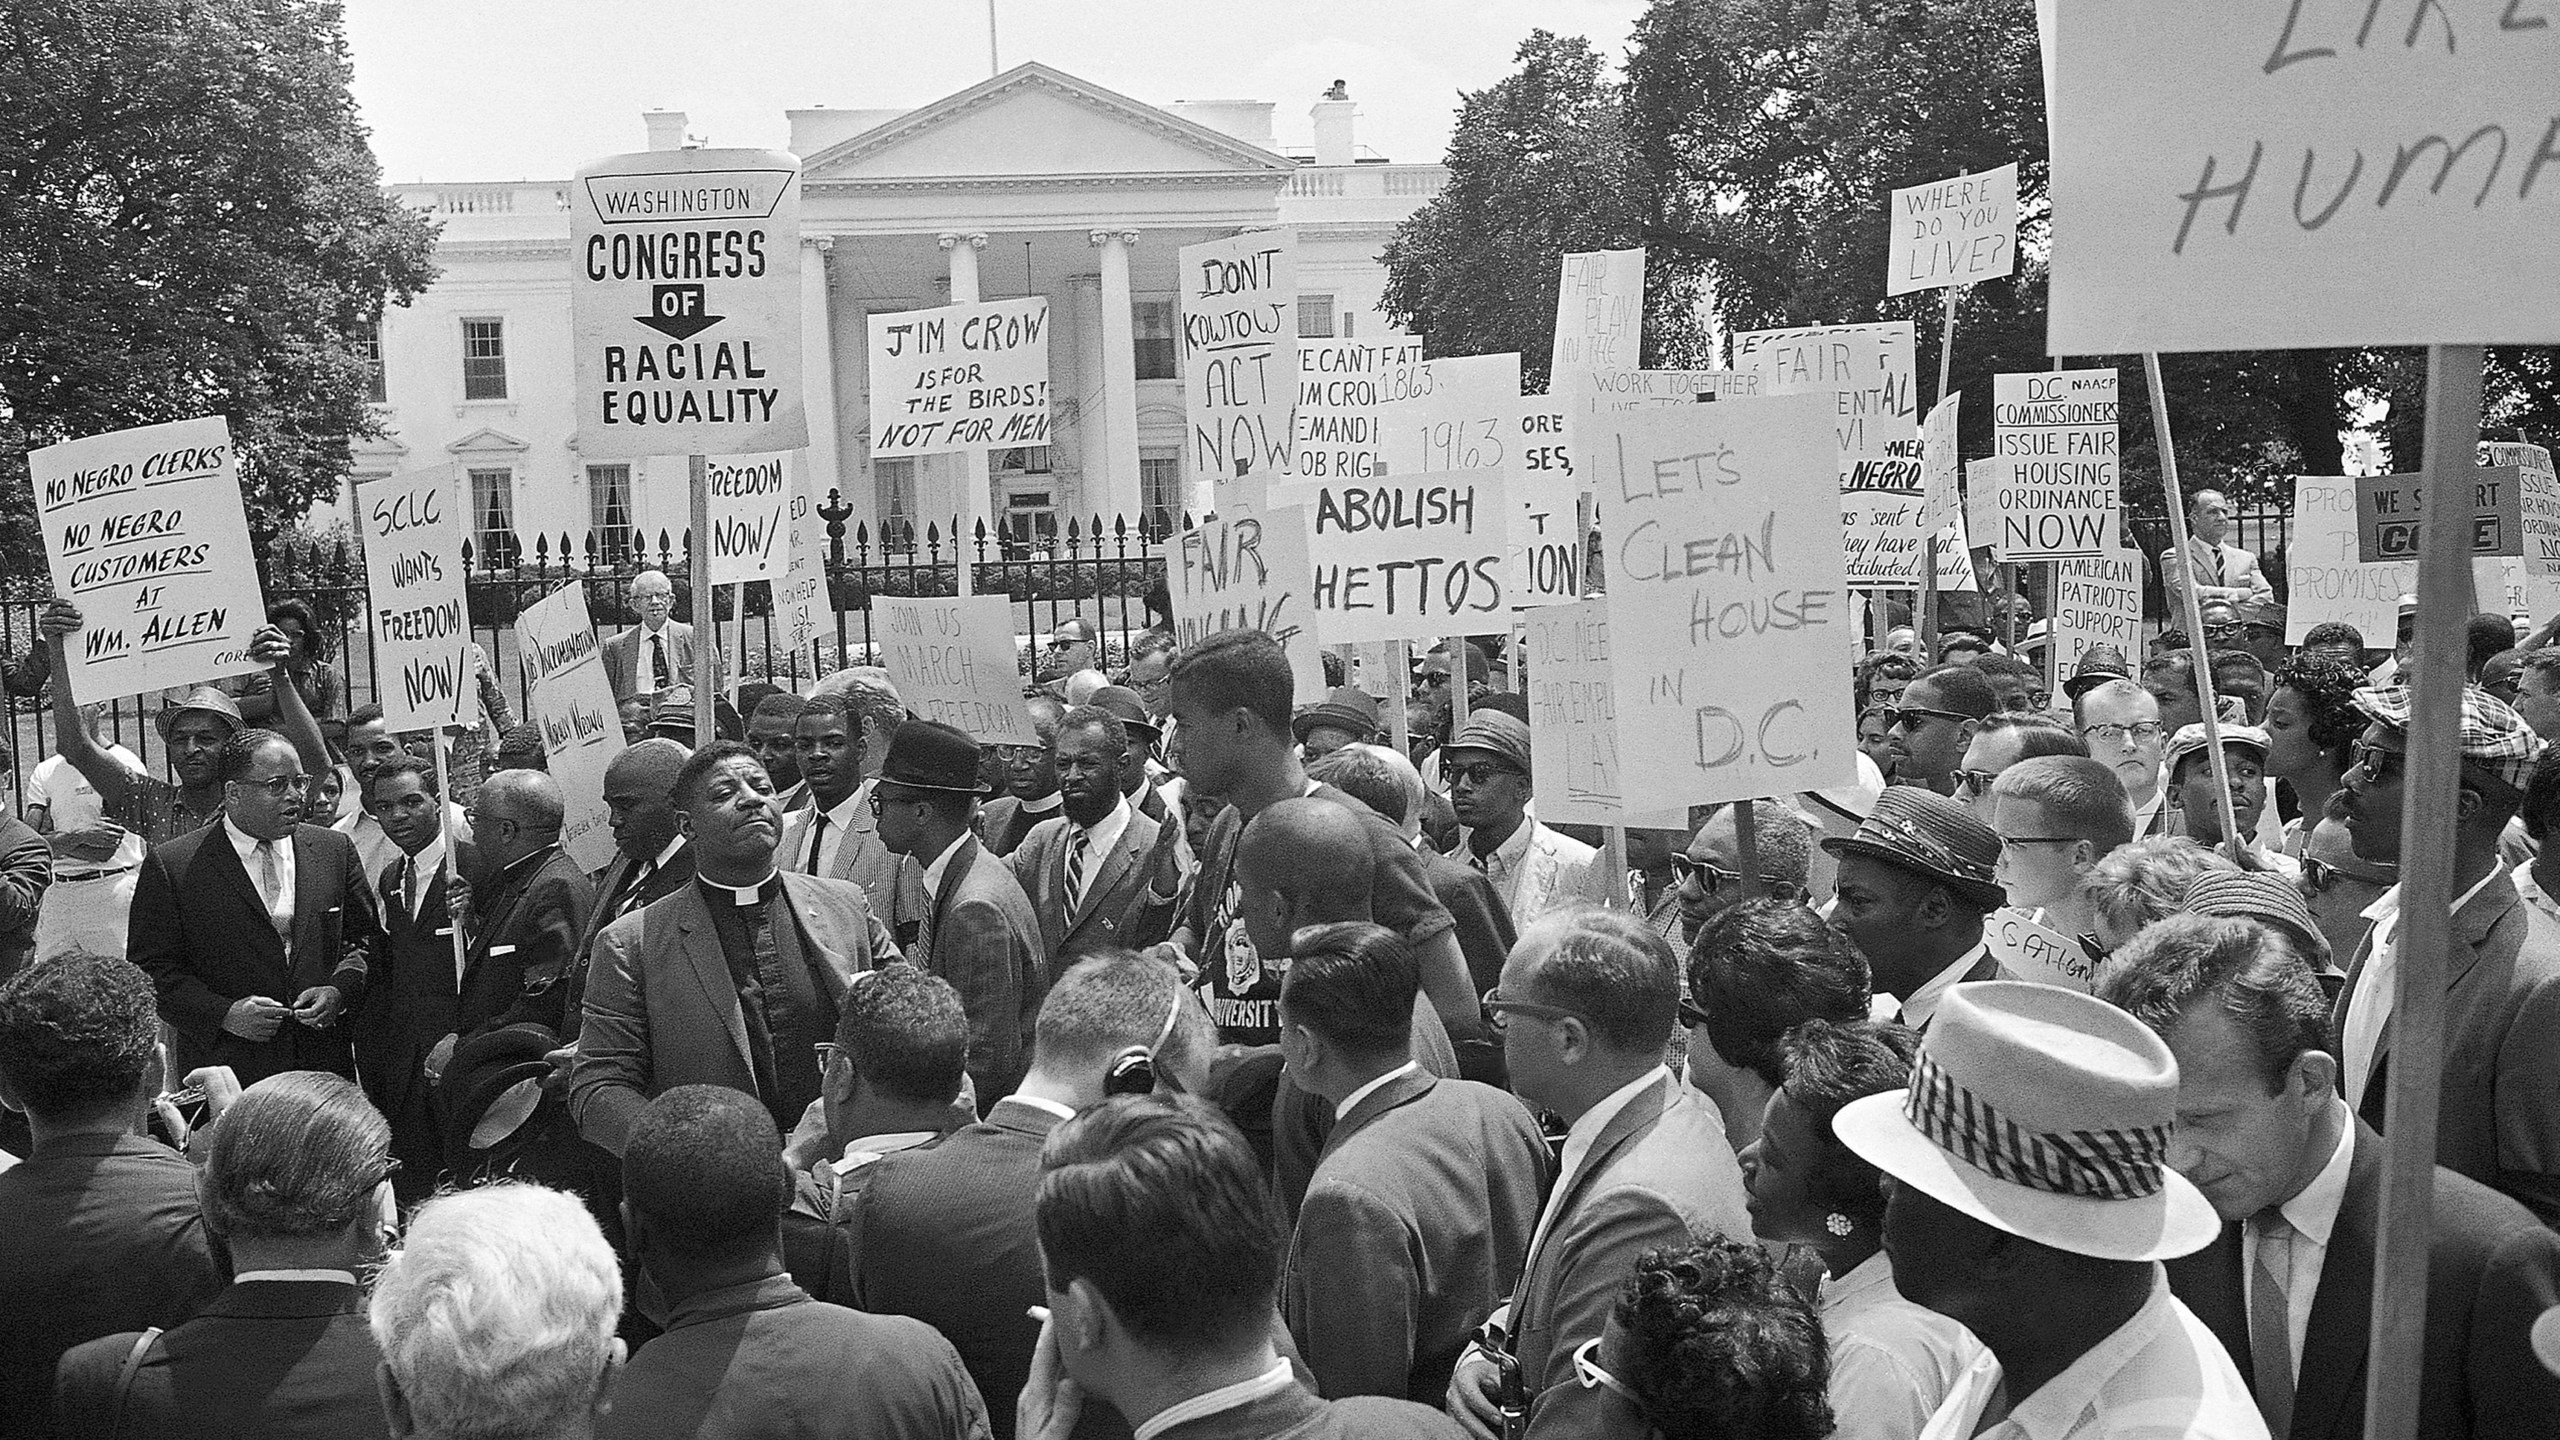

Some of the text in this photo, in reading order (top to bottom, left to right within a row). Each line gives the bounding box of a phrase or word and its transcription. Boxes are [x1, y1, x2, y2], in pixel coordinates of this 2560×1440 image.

[605, 188, 751, 214] WASHINGTON
[1906, 178, 1991, 215] WHERE
[1914, 207, 1999, 240] DO YOU
[586, 229, 766, 282] CONGRESS
[1566, 253, 1608, 296] FAIR
[1910, 234, 2006, 280] LIVE?
[660, 290, 698, 318] OF
[1585, 294, 1635, 336] PLAY
[885, 305, 1048, 356] JIM CROW
[1182, 302, 1288, 361] KOWTOW
[605, 340, 766, 383] RACIAL
[1561, 337, 1580, 363] IN
[1776, 343, 1851, 385] FAIR
[905, 380, 1047, 414] THE BIRDS!
[1205, 351, 1272, 408] ACT
[1592, 371, 1759, 396] WORK TOGETHER
[2028, 377, 2116, 400] D.C. NAACP
[602, 388, 779, 426] EQUALITY
[877, 421, 944, 449] NOT
[945, 417, 994, 444] FOR
[1195, 402, 1297, 473] NOW
[1299, 416, 1367, 443] EMAND
[2000, 431, 2117, 456] ISSUE FAIR
[45, 446, 225, 505] NO NEGRO CLERKS
[1301, 451, 1327, 476] OB
[1616, 434, 1742, 502] LET'S
[1850, 460, 1922, 489] NEGRO
[2014, 462, 2111, 485] HOUSING
[1316, 485, 1475, 534] ABOLISH
[2000, 489, 2117, 510] ORDINANCE
[2374, 489, 2399, 514] WE
[63, 509, 182, 551] NO NEGRO
[714, 505, 781, 571] NOW!
[1620, 510, 1776, 584] CLEAN
[1874, 529, 1918, 553] have
[2005, 513, 2105, 549] NOW
[70, 543, 210, 588] CUSTOMERS
[391, 550, 443, 589] WANTS
[1181, 518, 1268, 600] FAIR
[2060, 559, 2132, 582] AMERICAN
[136, 585, 166, 609] AT
[2062, 582, 2137, 613] PATRIOTS
[2293, 566, 2401, 602] PROMISES
[141, 607, 227, 646] ALLEN
[379, 598, 461, 643] FREEDOM
[934, 606, 961, 637] US
[1688, 588, 1836, 647] HOUSE
[2062, 609, 2139, 640] SUPPORT
[404, 646, 465, 722] NOW!
[896, 643, 978, 694] MARCH
[1649, 668, 1685, 706] IN
[1694, 698, 1819, 771] D.C.
